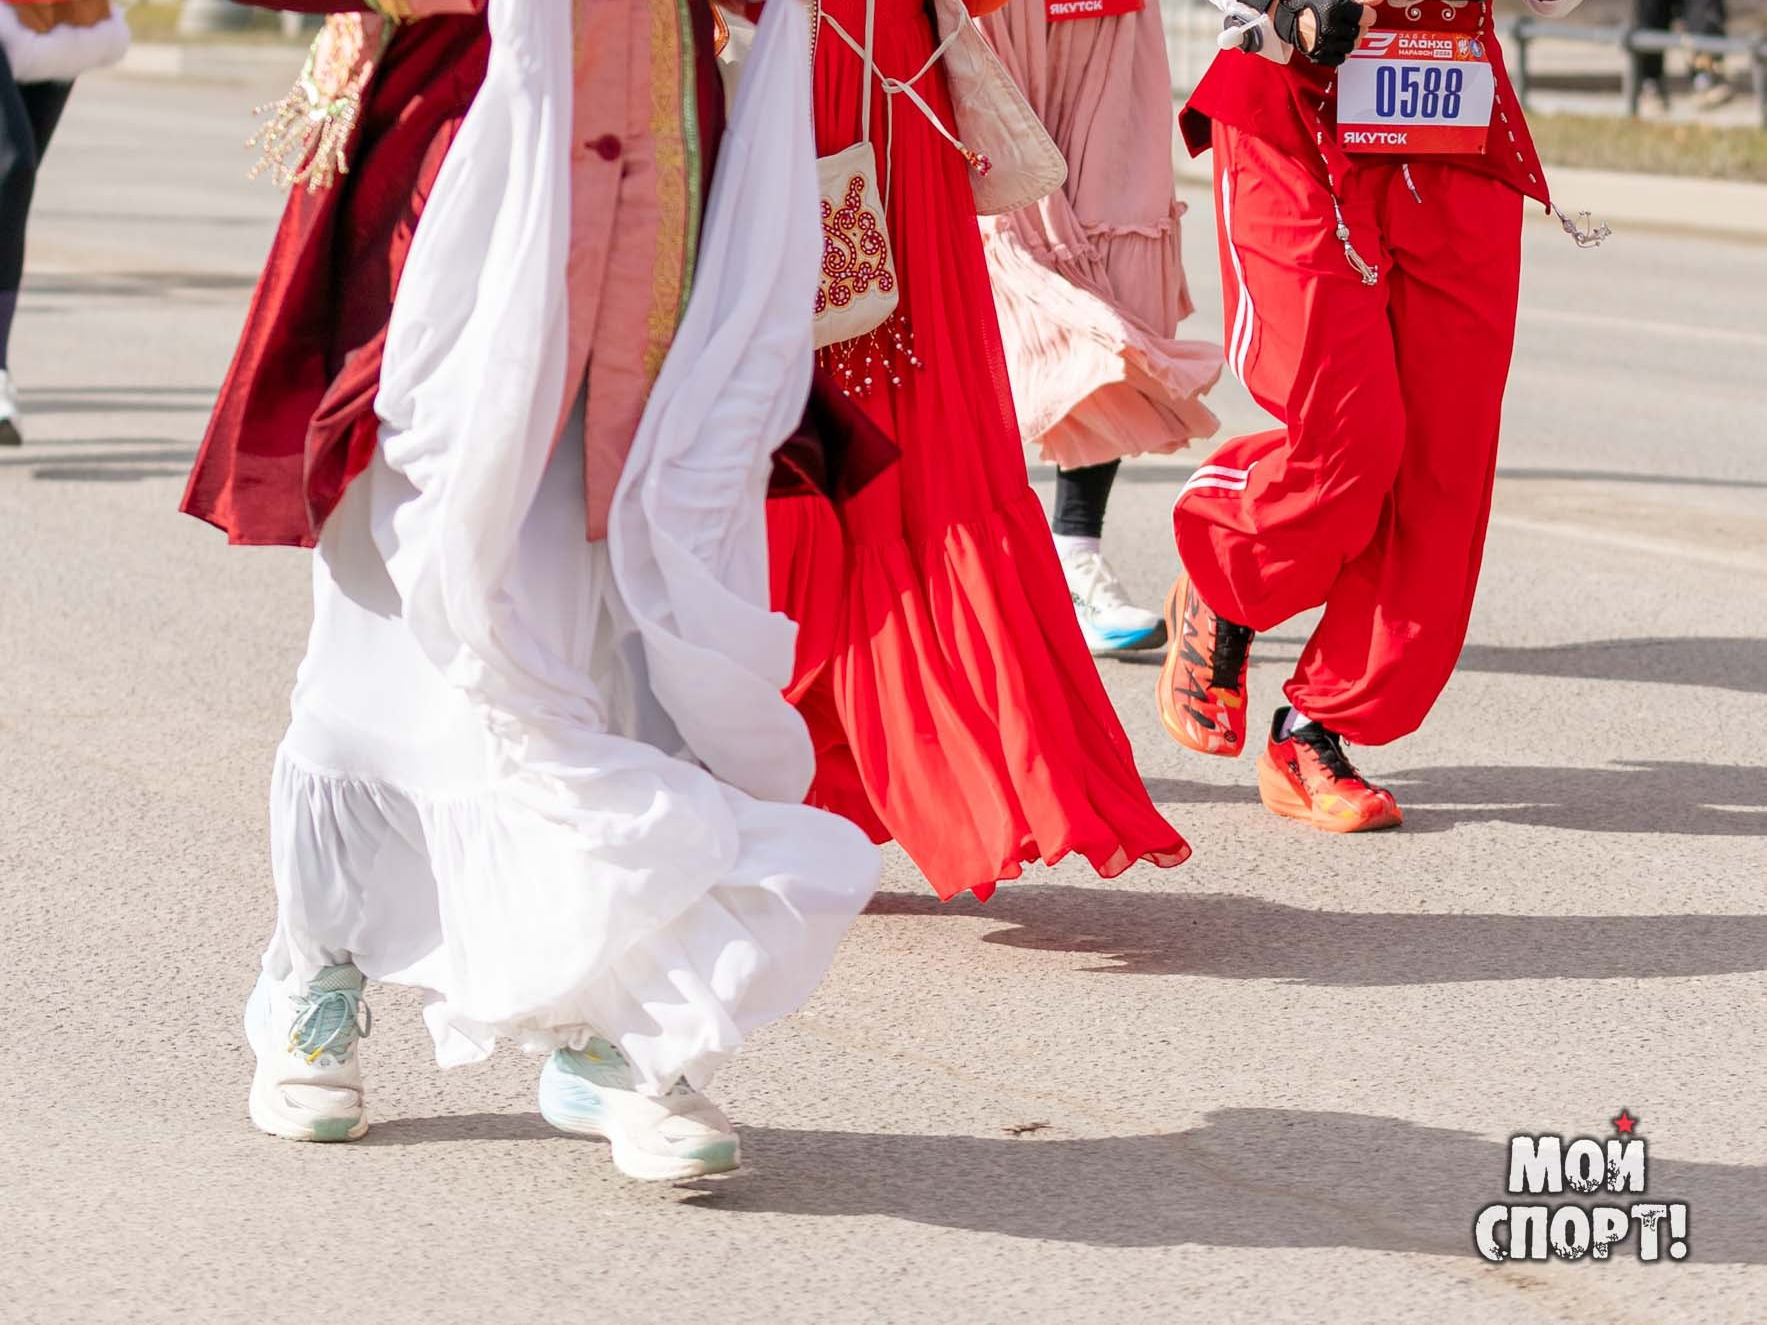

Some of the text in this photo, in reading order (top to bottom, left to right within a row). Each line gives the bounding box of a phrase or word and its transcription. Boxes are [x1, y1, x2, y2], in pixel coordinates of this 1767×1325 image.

[1049, 0, 1103, 15] ЯКУТСК
[1398, 39, 1452, 49] ОЛОНХО
[1376, 66, 1463, 118] 0588
[1343, 131, 1407, 145] ЯКУТСК
